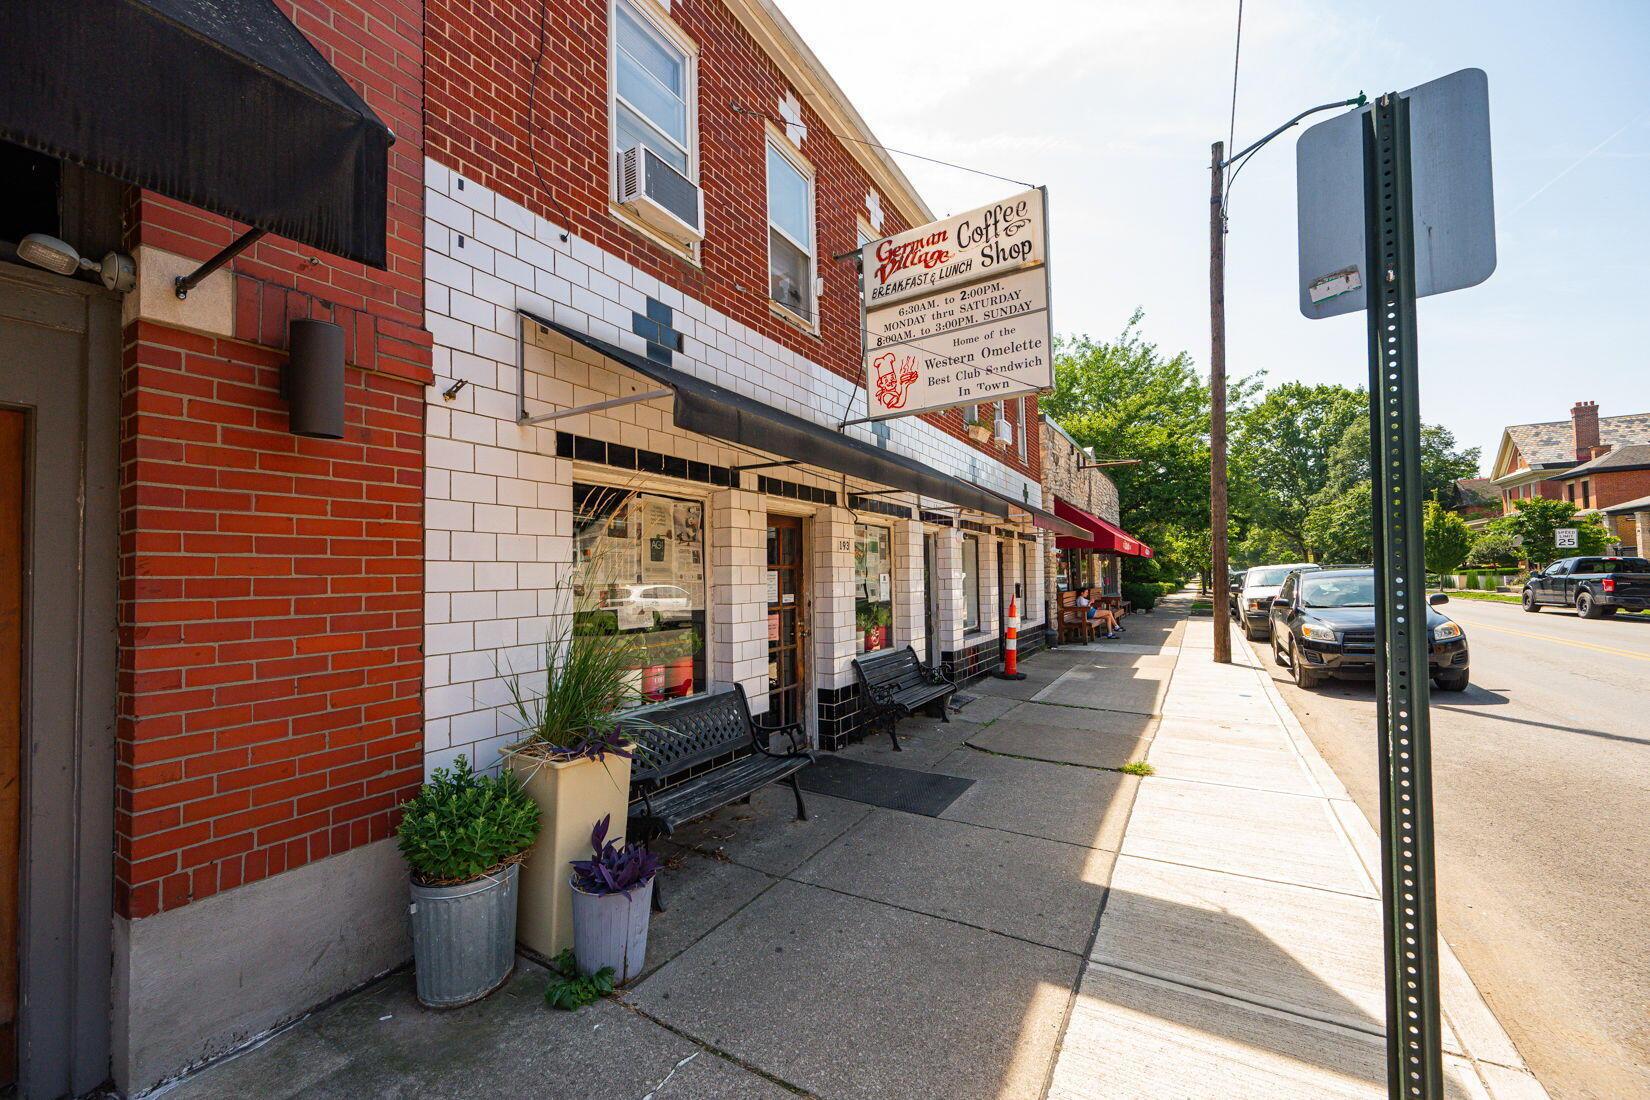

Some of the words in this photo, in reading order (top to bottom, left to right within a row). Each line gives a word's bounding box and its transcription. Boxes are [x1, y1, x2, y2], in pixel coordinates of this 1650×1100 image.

[957, 200, 1029, 249] Coffee
[875, 229, 949, 263] German
[980, 239, 1033, 268] Shop
[871, 272, 930, 299] BREAKFAST
[930, 272, 936, 286] &
[938, 258, 973, 280] LUNCH
[874, 248, 952, 285] Village
[883, 313, 927, 333] MONDAY
[932, 308, 955, 321] thru
[959, 289, 1022, 314] SATURDAY
[898, 300, 940, 317] 6:30AM.
[944, 297, 955, 305] to
[960, 282, 1005, 301] 2:00PM.
[876, 329, 916, 347] 8:00AM.
[921, 327, 931, 336] to
[935, 314, 978, 332] 3:00PM.
[983, 300, 1033, 321] SUNDAY
[953, 335, 980, 347] Home
[984, 330, 995, 340] of
[999, 327, 1016, 337] the
[924, 353, 975, 370] Western
[981, 338, 1042, 359] Omelette
[927, 375, 950, 387] Best
[955, 366, 981, 382] Club
[958, 385, 971, 397] In
[976, 380, 1010, 392] Town
[839, 540, 850, 551] 193
[1558, 538, 1576, 546] 25
